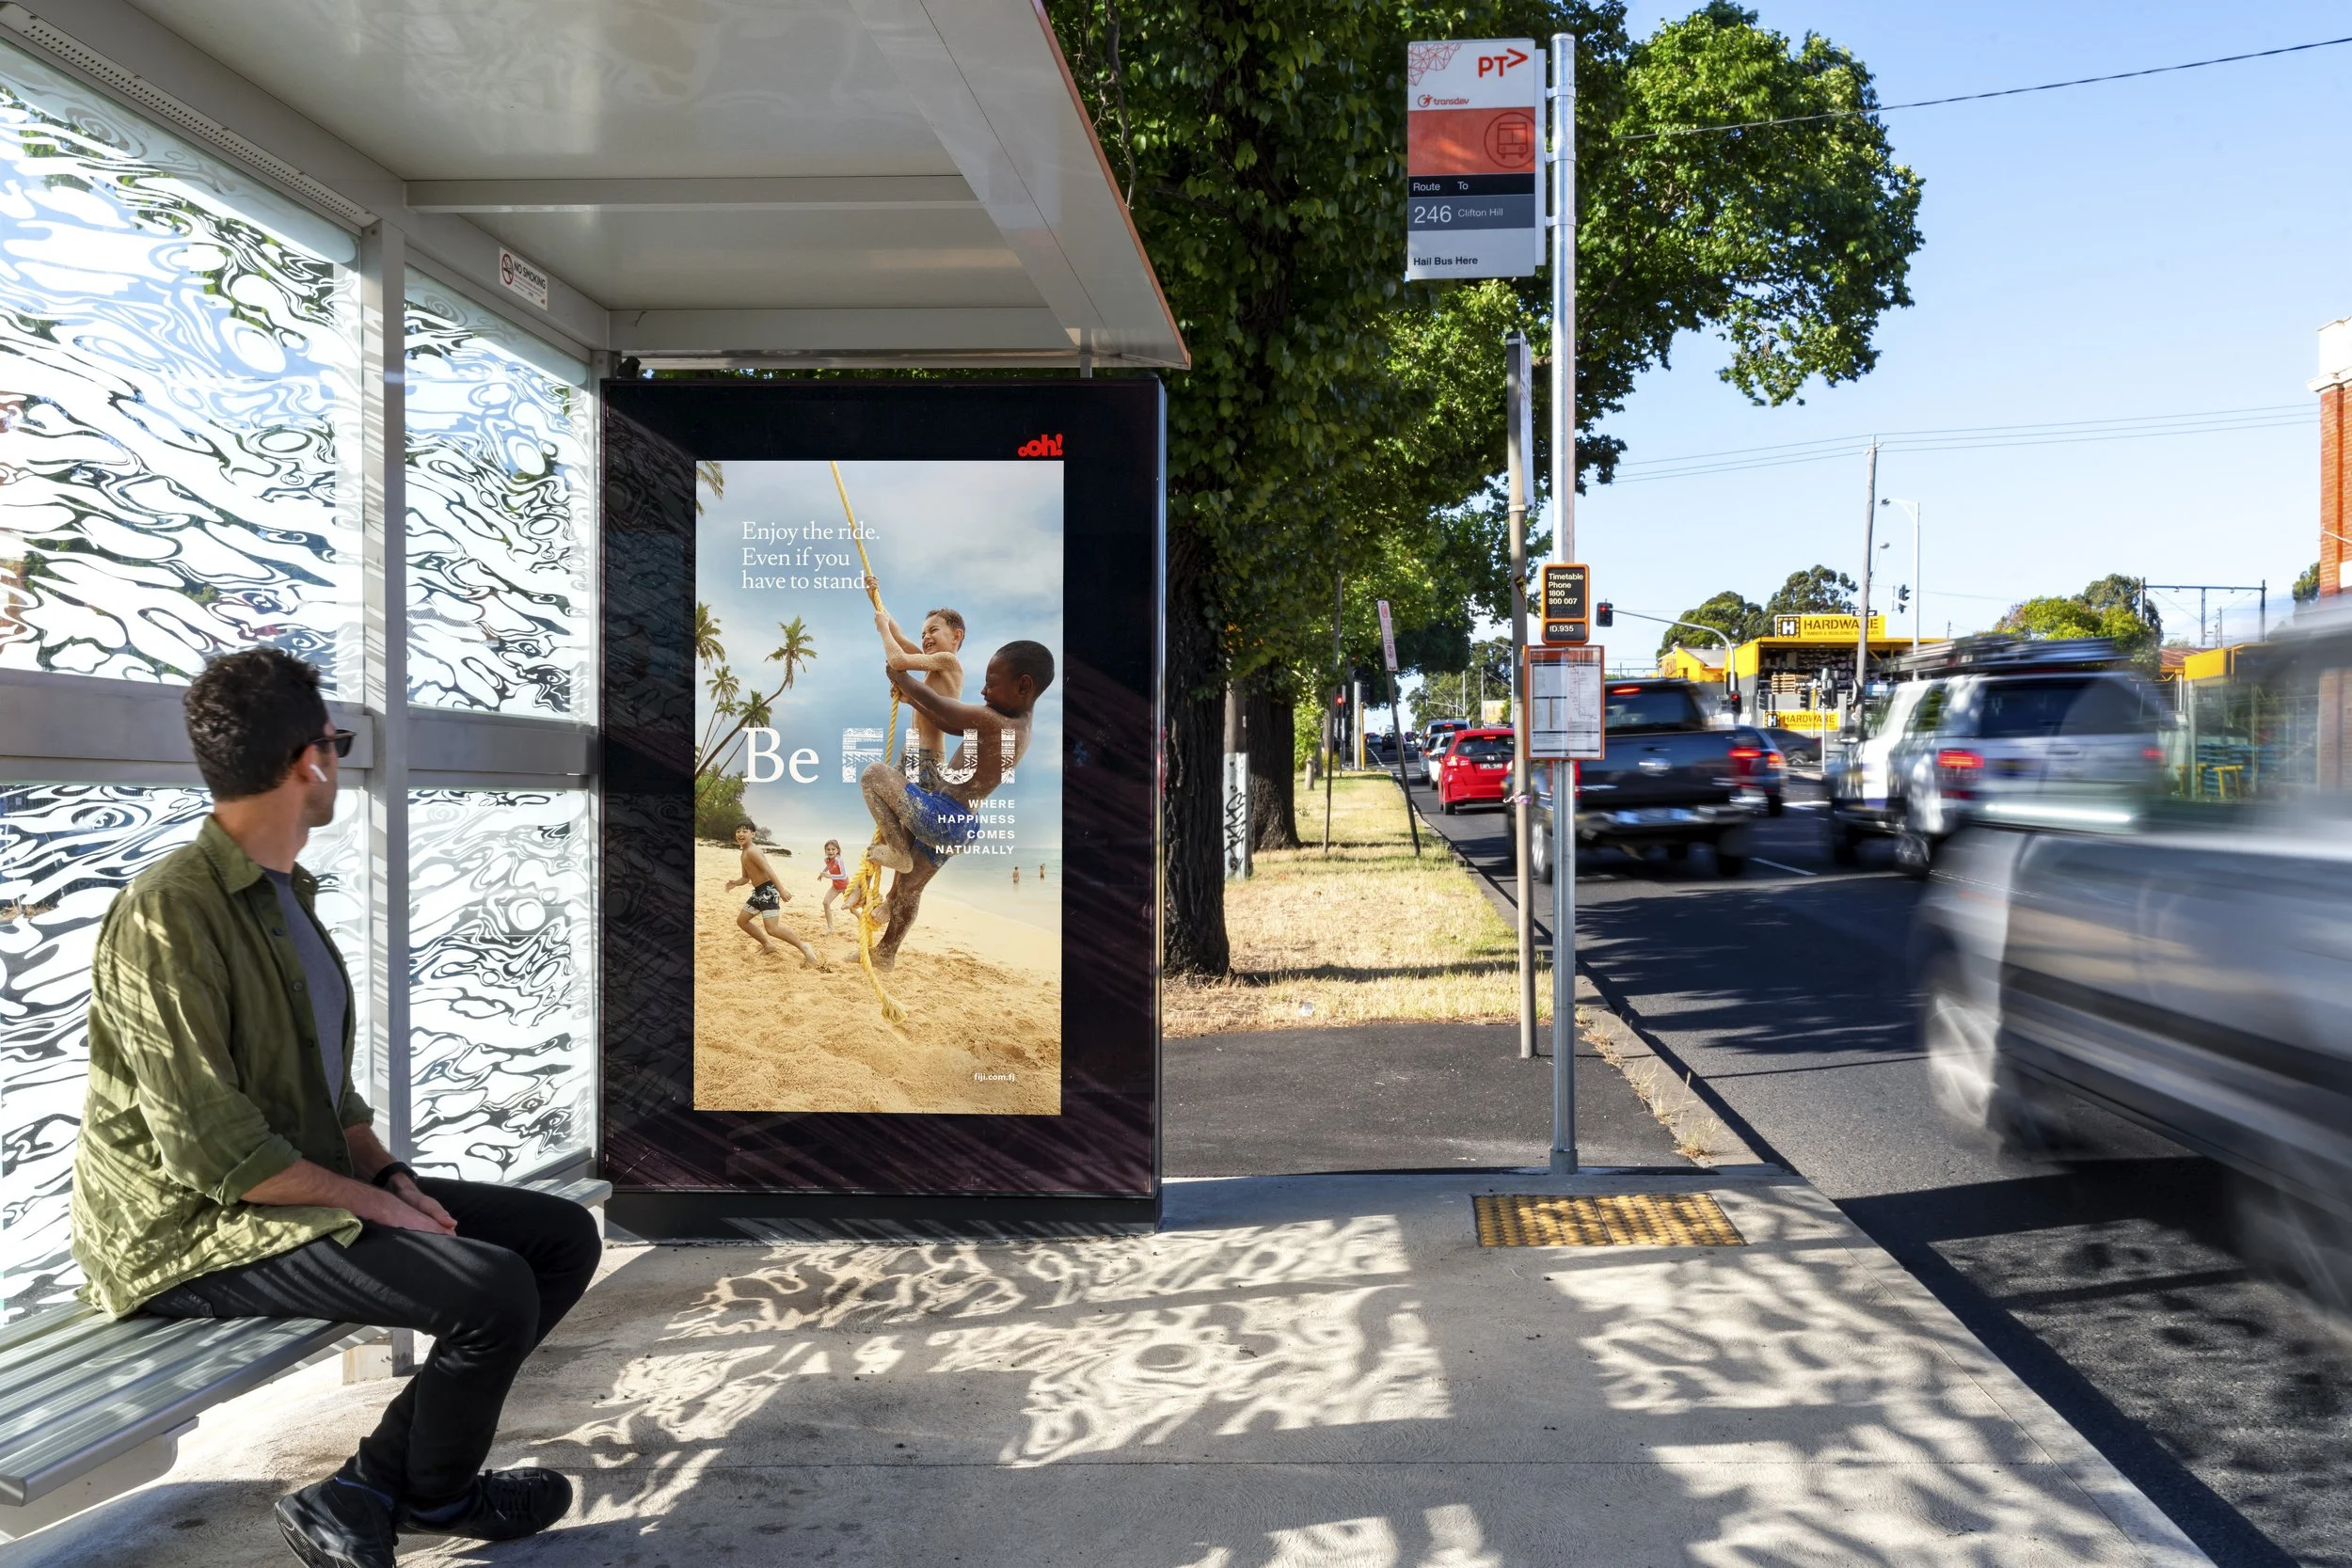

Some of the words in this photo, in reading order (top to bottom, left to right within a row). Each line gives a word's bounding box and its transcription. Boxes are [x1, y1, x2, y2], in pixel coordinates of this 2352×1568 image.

[1413, 182, 1440, 191] Route
[1457, 182, 1469, 190] To
[1414, 205, 1452, 223] 246
[1457, 209, 1486, 217] Clifton
[1489, 208, 1503, 216] Hill
[1413, 258, 1432, 266] Hail
[1434, 257, 1453, 265] Bus
[514, 261, 522, 274] NO
[523, 267, 546, 289] SMOKING
[741, 521, 799, 546] Enjoy
[803, 520, 834, 540] the
[837, 520, 881, 540] ride.
[741, 546, 790, 566] Even
[795, 546, 813, 566] if
[814, 553, 850, 572] you
[741, 570, 787, 589] have
[790, 576, 809, 589] to
[813, 569, 870, 589] stand.
[1804, 619, 1879, 630] HARDWAE
[741, 727, 819, 784] Be
[842, 727, 1016, 784] FIJI
[968, 800, 1015, 809] WHERE
[938, 815, 1015, 824] HAPPINESS
[967, 830, 1015, 840] COMES
[935, 845, 1014, 855] NATURALLY
[974, 1072, 1016, 1082] fiji.com.fj
